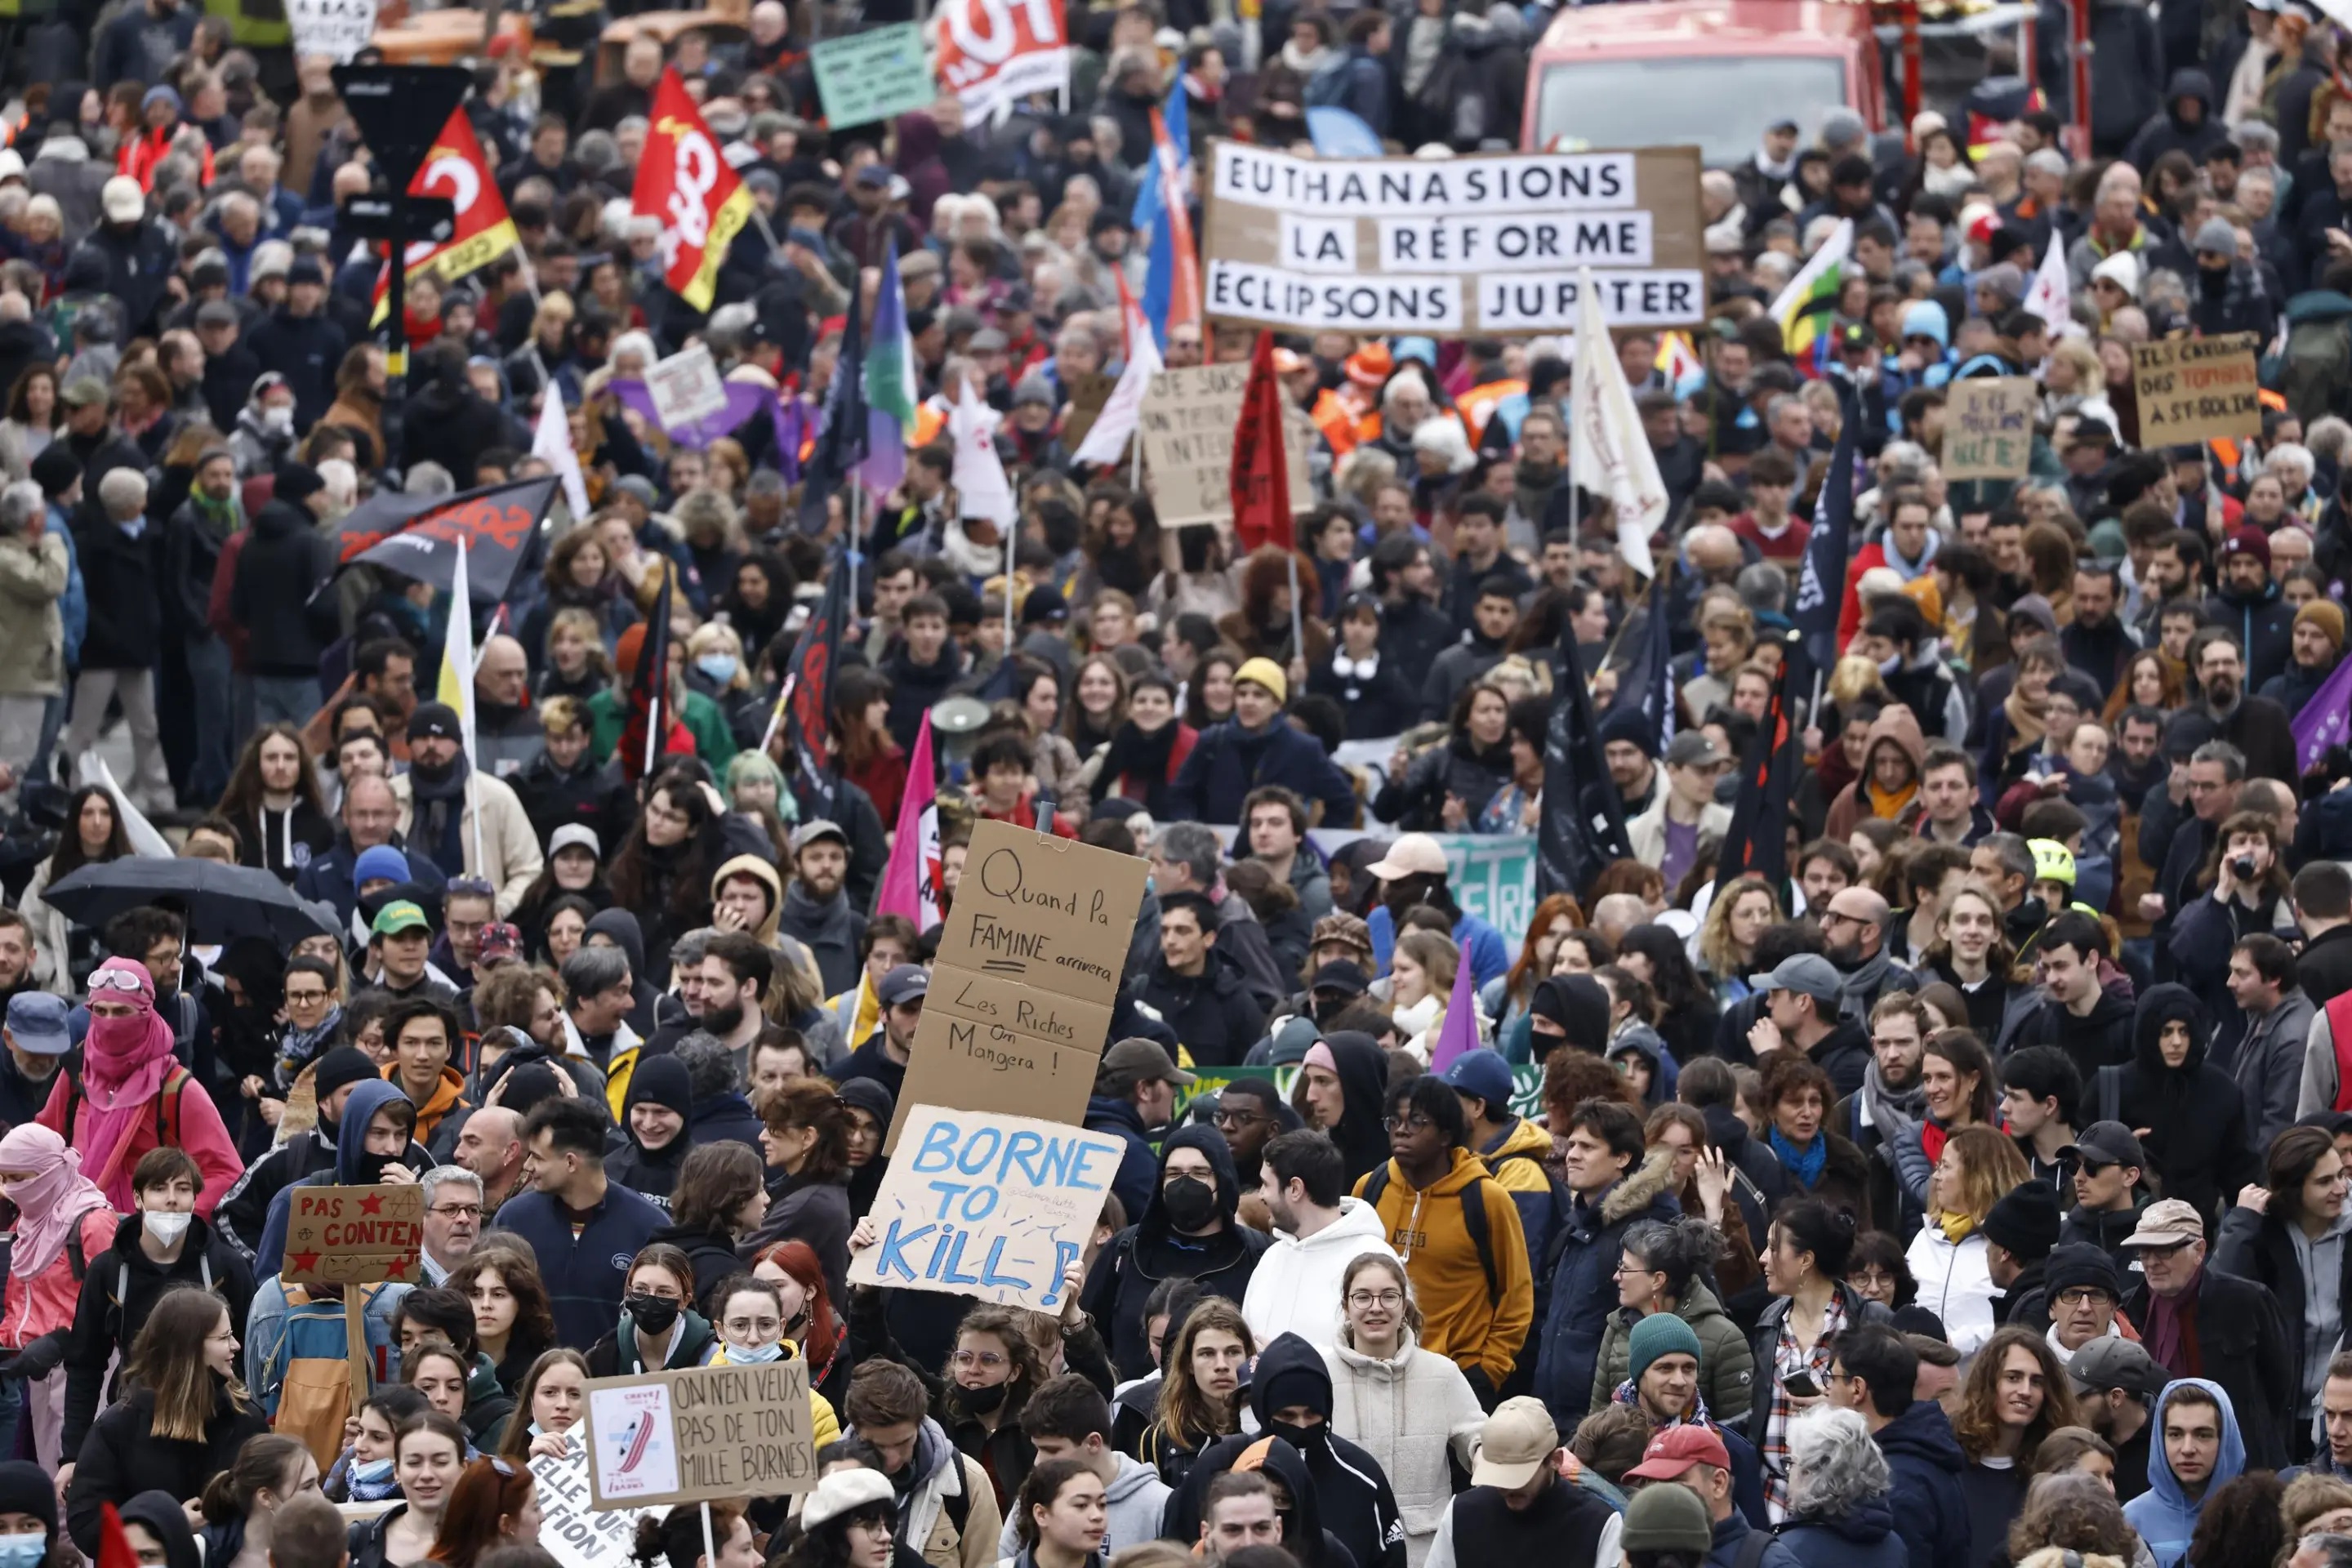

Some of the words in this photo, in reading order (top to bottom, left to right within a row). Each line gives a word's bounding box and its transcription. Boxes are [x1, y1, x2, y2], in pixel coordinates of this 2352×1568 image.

[1231, 157, 1620, 203] EUTHANASIONS
[1294, 226, 1344, 261] LA
[1395, 216, 1637, 260] RÉFORME
[1214, 260, 1447, 319] ÉCLIPSONS
[2140, 372, 2175, 397] DES
[981, 848, 1077, 916] Quand
[969, 913, 1051, 962] FAMINE
[1055, 954, 1112, 981] arrivera
[954, 980, 998, 1016] Les
[1016, 1000, 1075, 1040] Riches
[949, 1022, 1035, 1071] Mangera
[911, 1120, 1119, 1192] BORNE
[301, 1196, 344, 1218] PAS
[928, 1180, 1000, 1222] TO
[323, 1220, 423, 1247] CONTEN
[674, 1376, 706, 1410] ON
[710, 1372, 749, 1405] N'EN
[754, 1366, 802, 1402] VEUX
[677, 1414, 716, 1449] PAS
[724, 1413, 746, 1443] DE
[753, 1409, 795, 1437] TON
[532, 1457, 588, 1503] ELLE
[679, 1449, 733, 1489] MILLE
